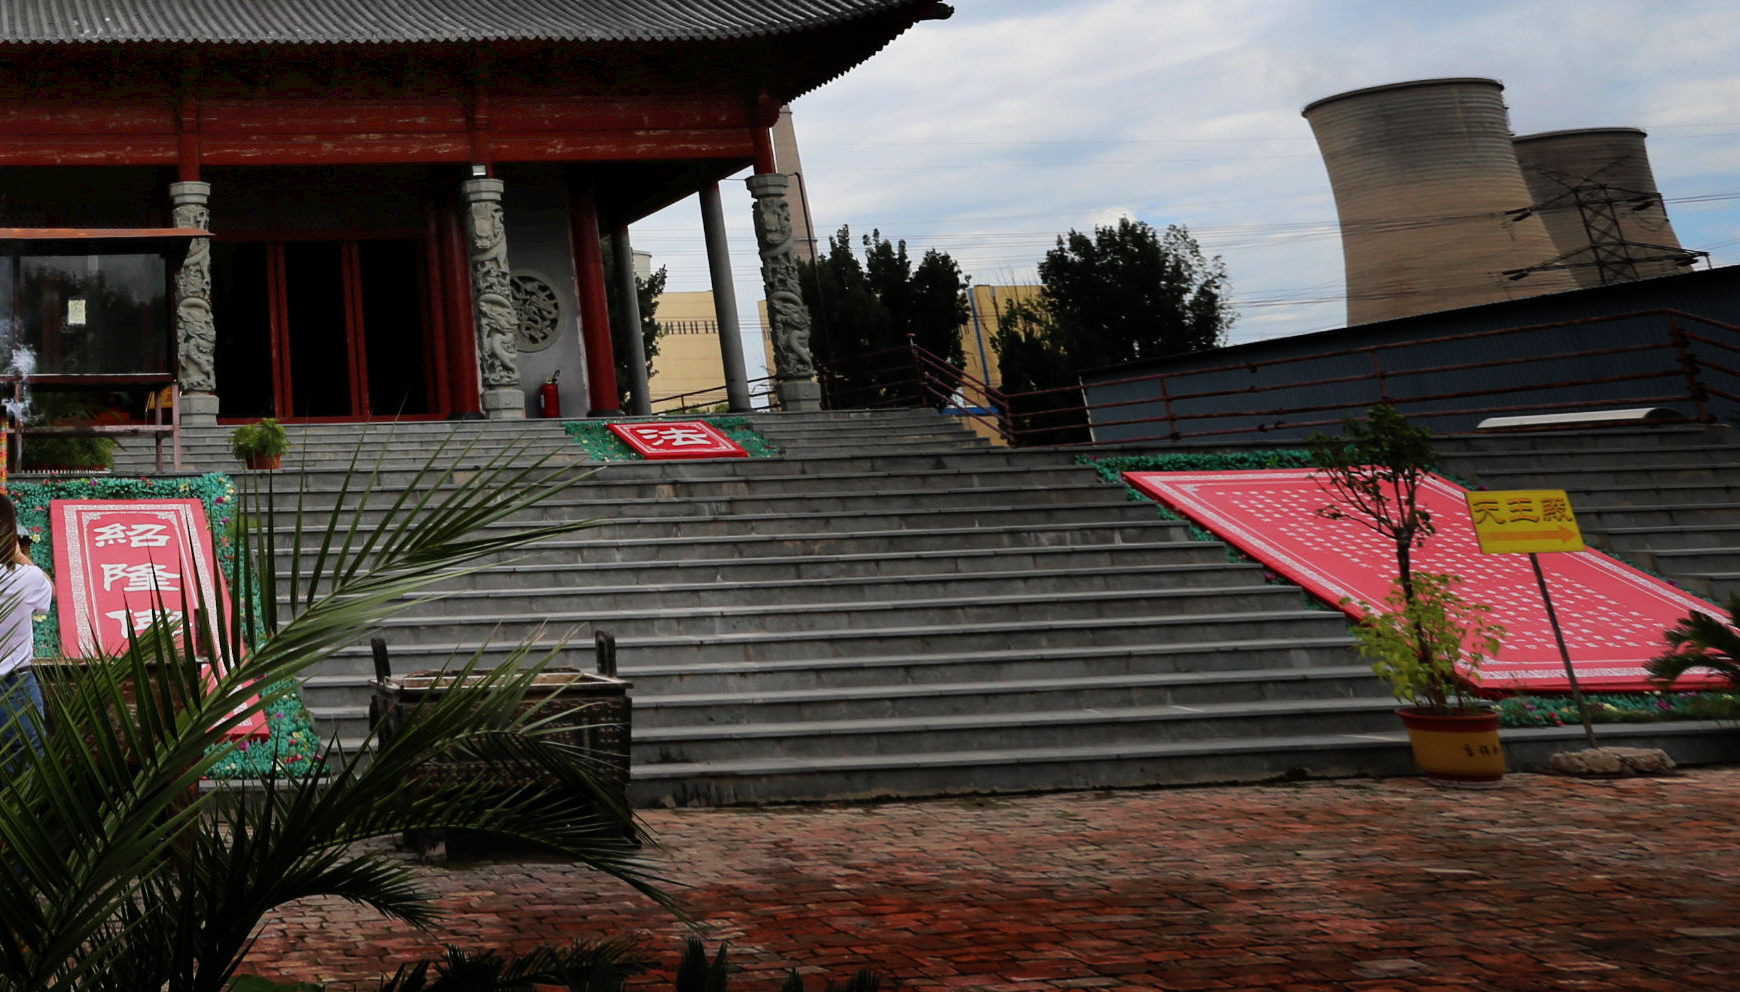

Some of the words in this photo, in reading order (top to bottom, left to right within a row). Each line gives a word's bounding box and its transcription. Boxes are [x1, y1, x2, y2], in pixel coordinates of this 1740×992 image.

[636, 428, 711, 446] 法
[1473, 498, 1574, 524] 天王殿
